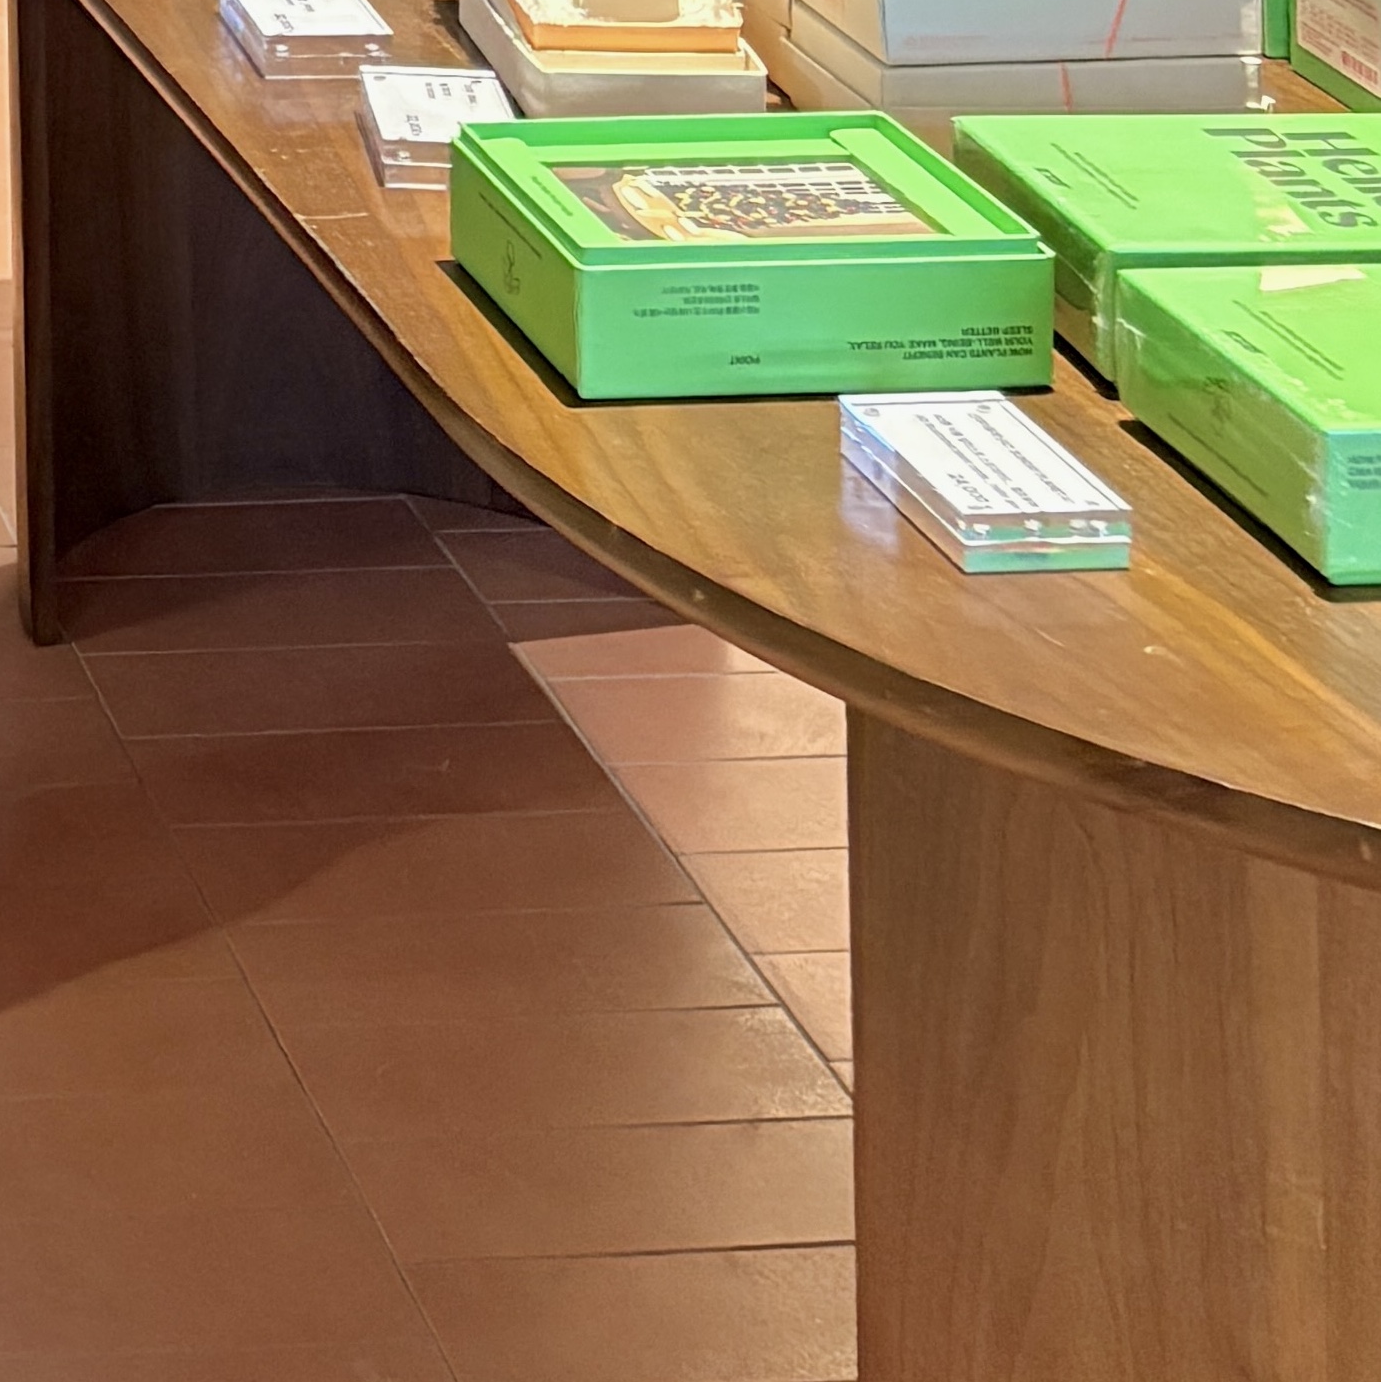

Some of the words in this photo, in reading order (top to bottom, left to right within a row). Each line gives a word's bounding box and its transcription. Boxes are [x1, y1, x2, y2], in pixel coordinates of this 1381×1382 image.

[1281, 132, 1381, 207] Hel
[961, 325, 1000, 336] BETTER
[1002, 325, 1033, 336] SLEEP
[885, 340, 905, 349] YOU
[908, 340, 937, 349] MAKE
[1005, 337, 1033, 346] YOUR
[903, 350, 943, 360] BENEFIT
[945, 349, 967, 358] CAN
[969, 348, 1009, 357] PLANTS
